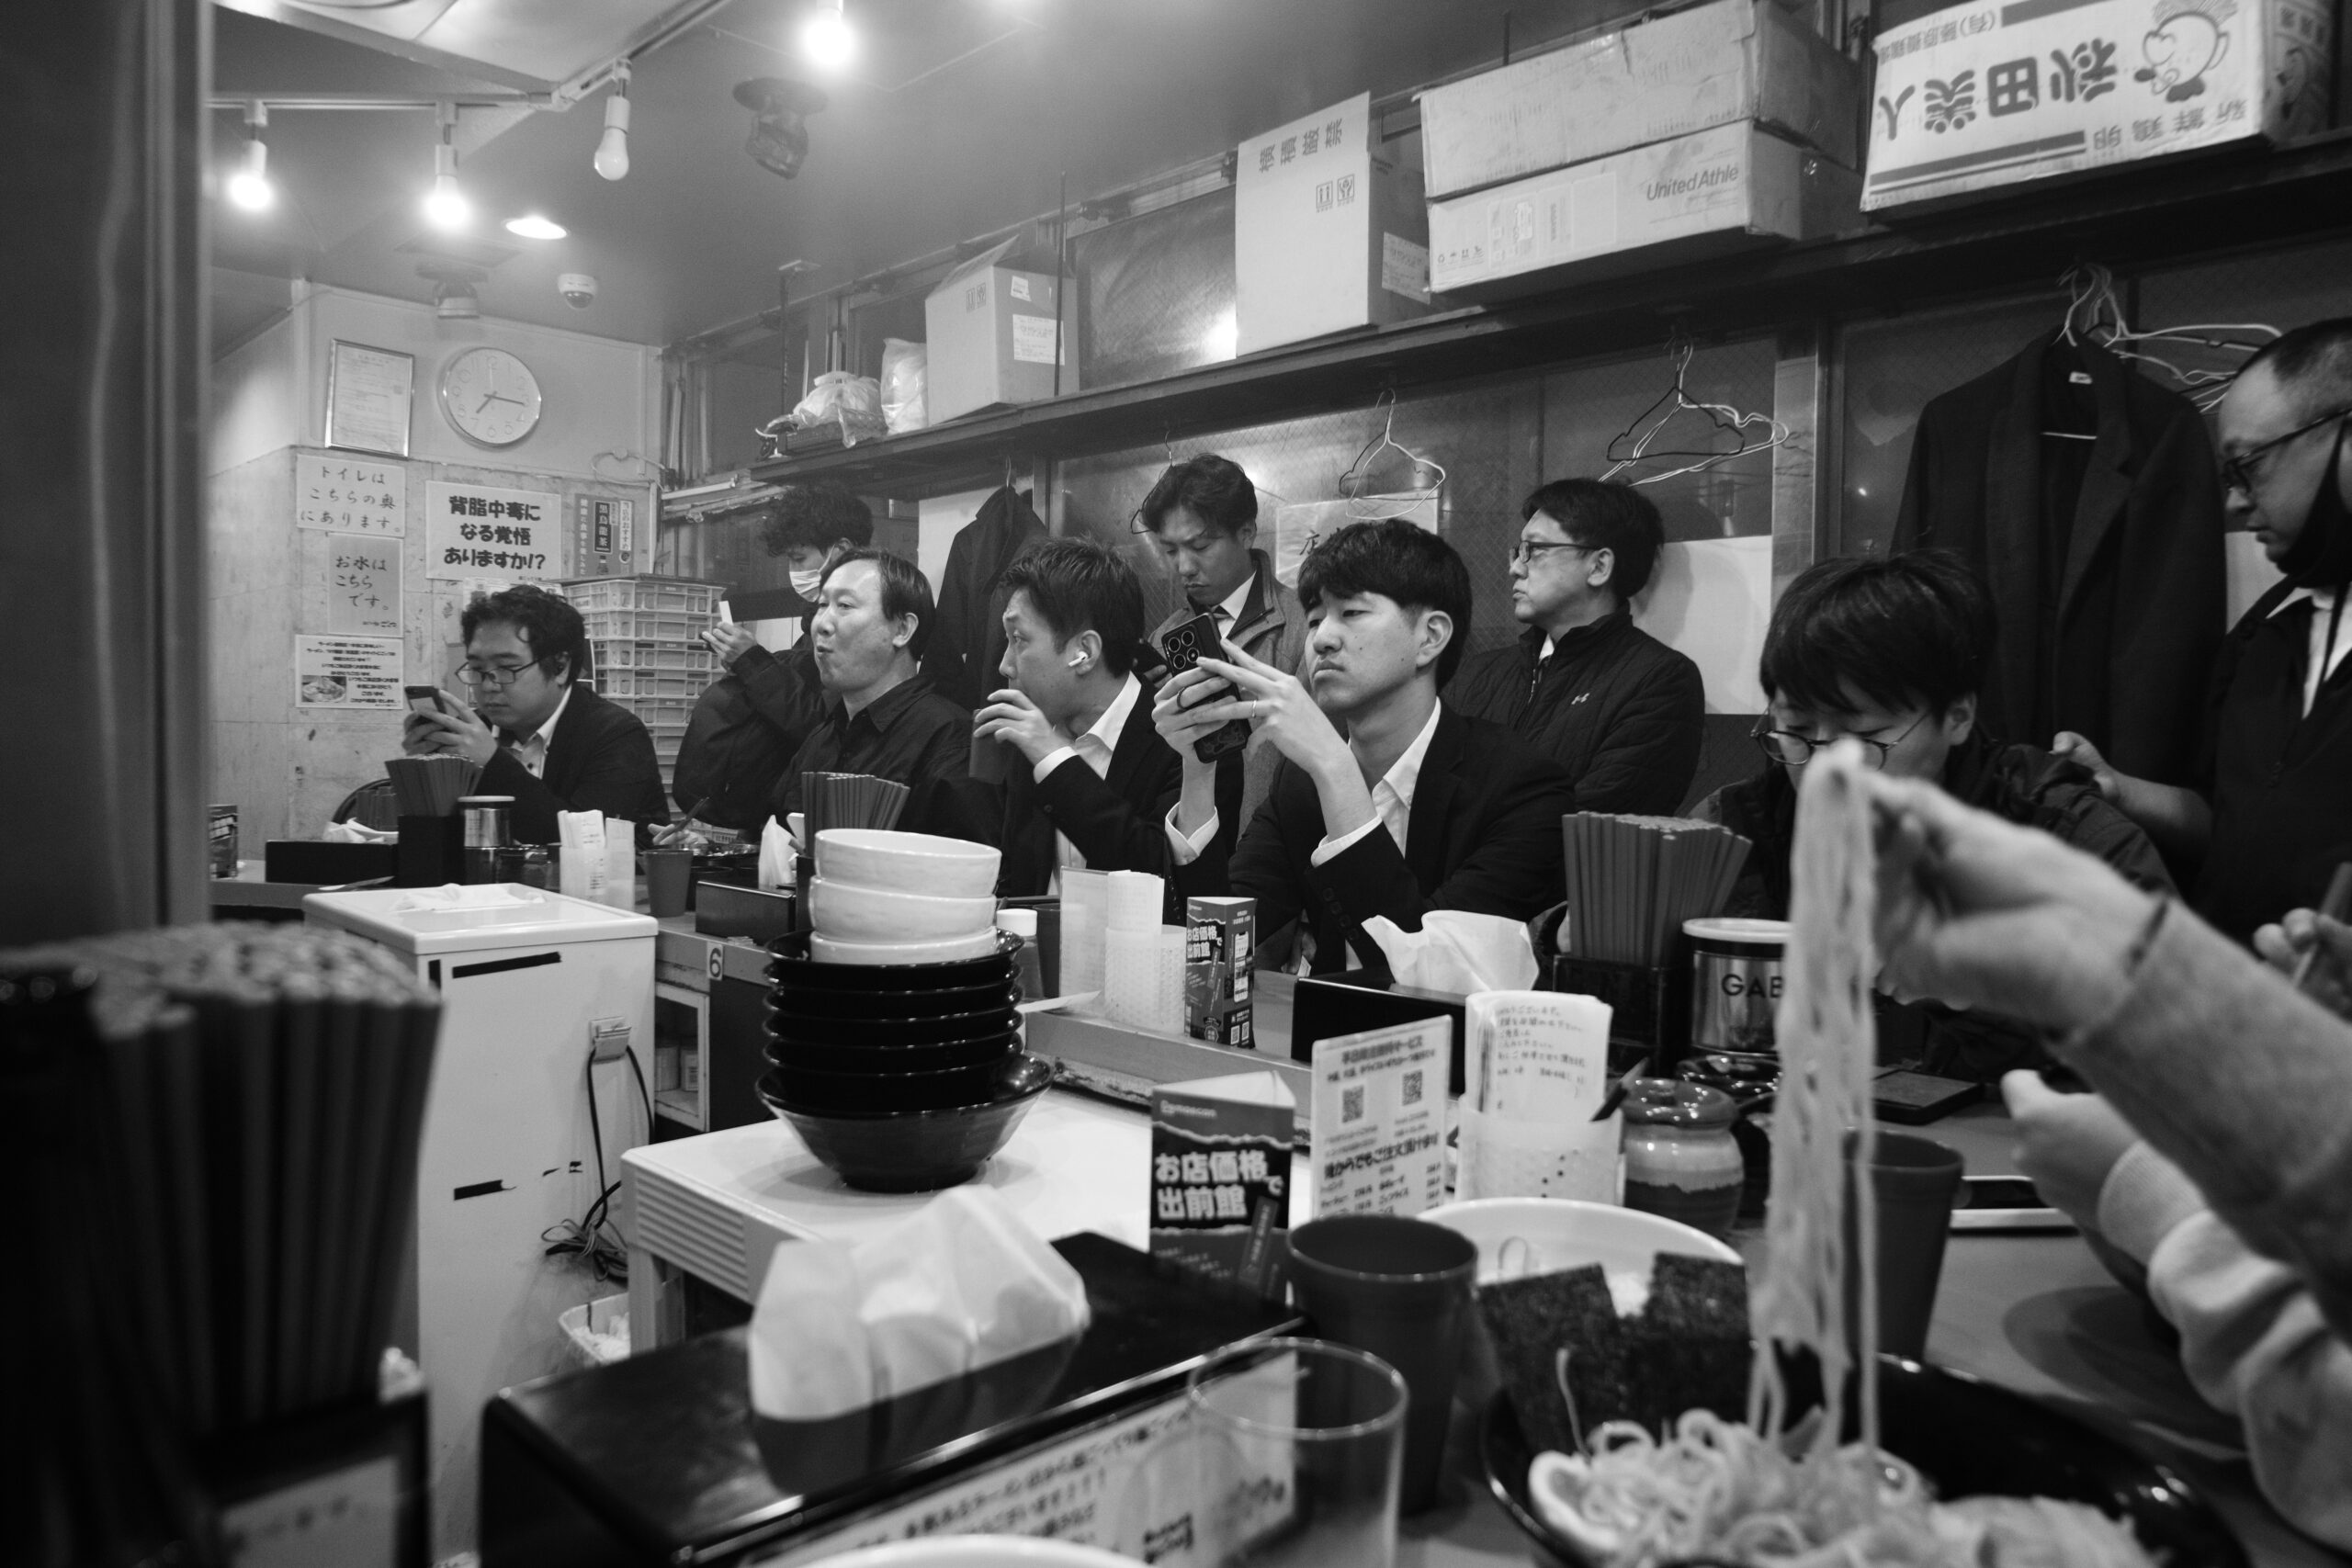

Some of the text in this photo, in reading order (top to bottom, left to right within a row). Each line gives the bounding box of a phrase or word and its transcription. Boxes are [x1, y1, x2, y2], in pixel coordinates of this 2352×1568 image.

[1878, 37, 2118, 141] 秋田美人
[1259, 118, 1342, 173] 横積厳禁
[1646, 172, 1698, 201] United
[1697, 164, 1739, 190] Athle
[322, 466, 386, 485] トイレは
[310, 488, 397, 511] こちらの奥
[448, 495, 541, 521] 背脂中毒に
[300, 510, 401, 533] にあります。
[459, 523, 531, 546] なる覚悟
[335, 555, 387, 571] お水は
[334, 574, 373, 590] こちら
[348, 592, 389, 611] です。
[708, 947, 721, 978] 6
[1157, 1185, 1247, 1220] 出前館
